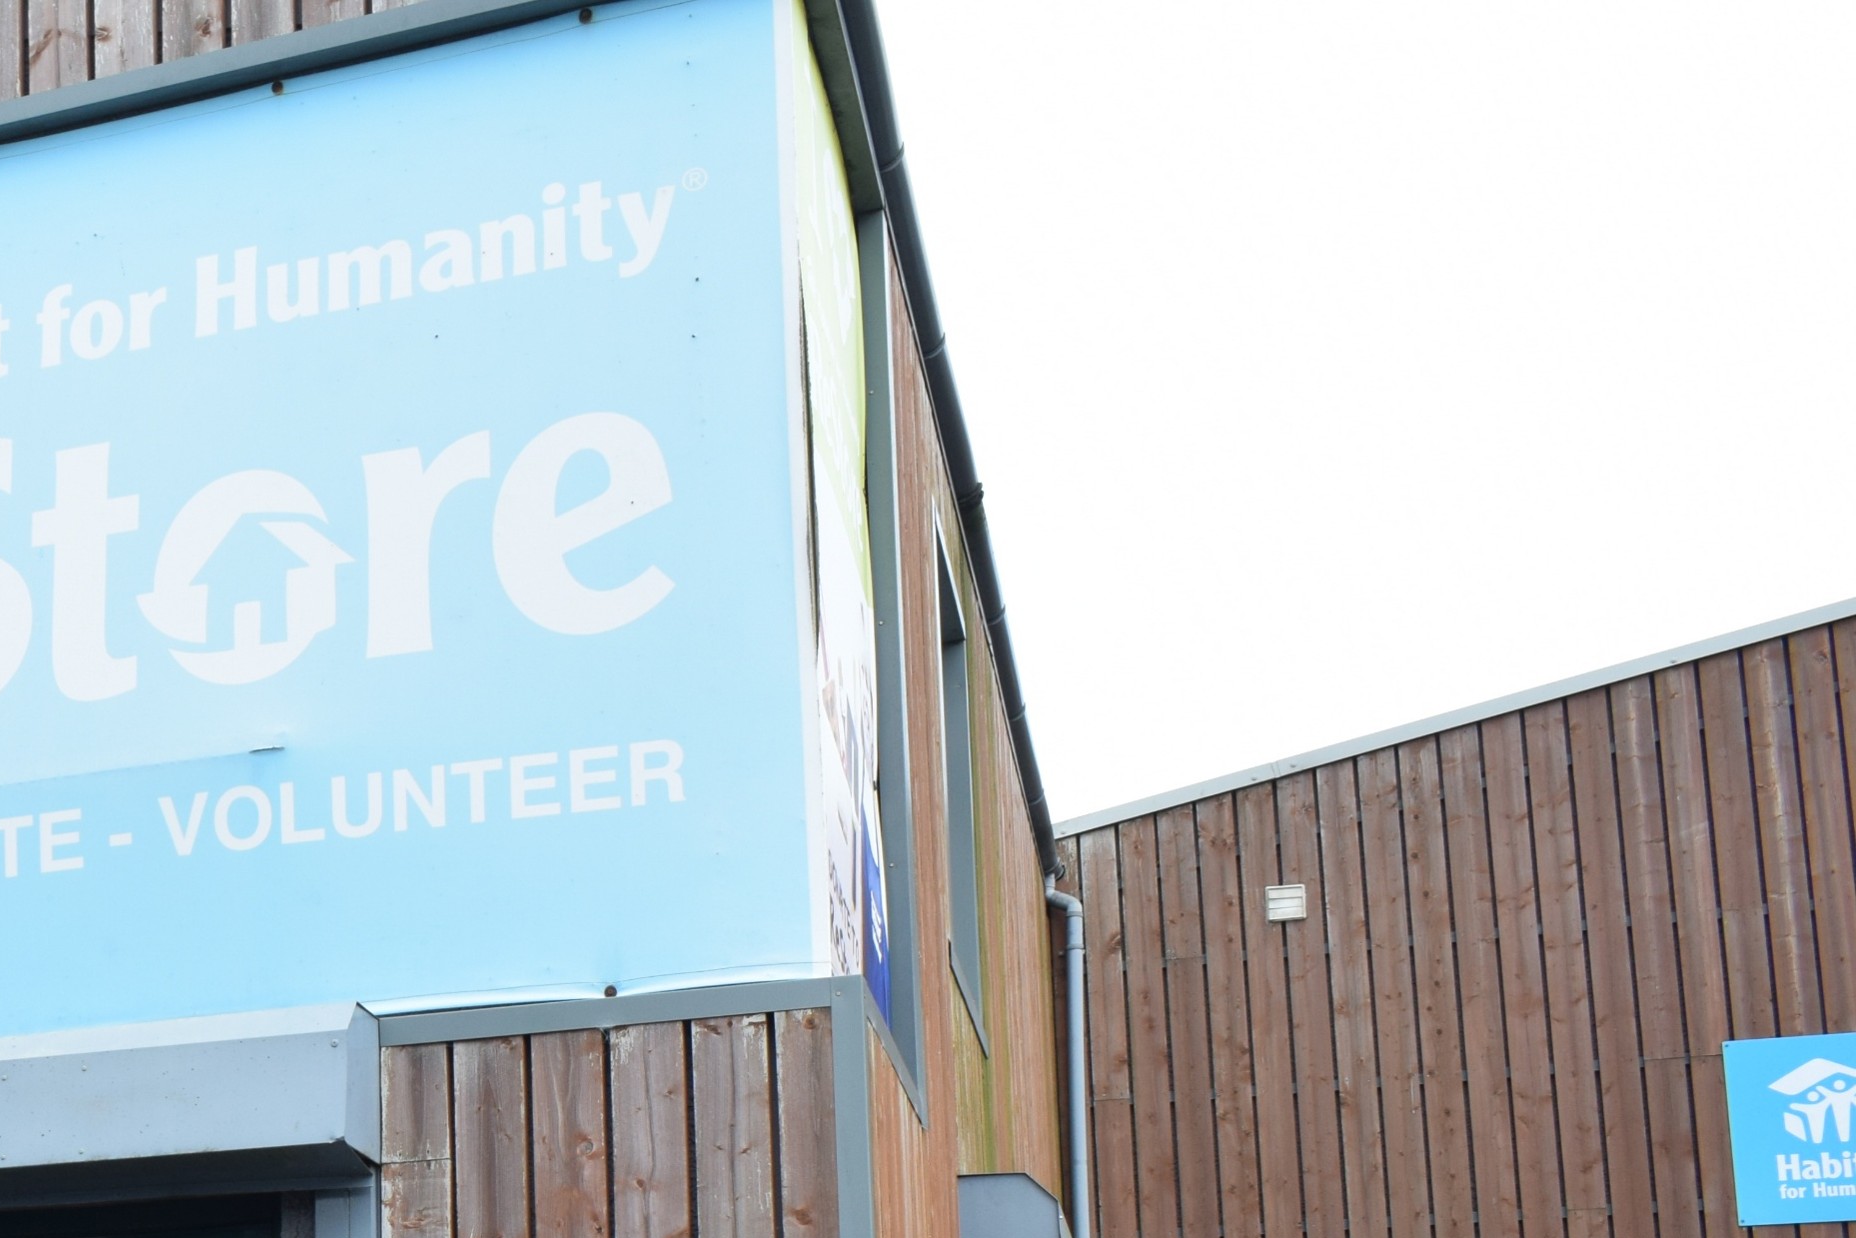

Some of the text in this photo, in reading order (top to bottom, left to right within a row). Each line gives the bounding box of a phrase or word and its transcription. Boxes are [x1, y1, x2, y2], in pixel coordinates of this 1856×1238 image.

[36, 283, 167, 369] for
[158, 739, 686, 857] VOLUNTEER
[1779, 1182, 1856, 1199] for Hum
